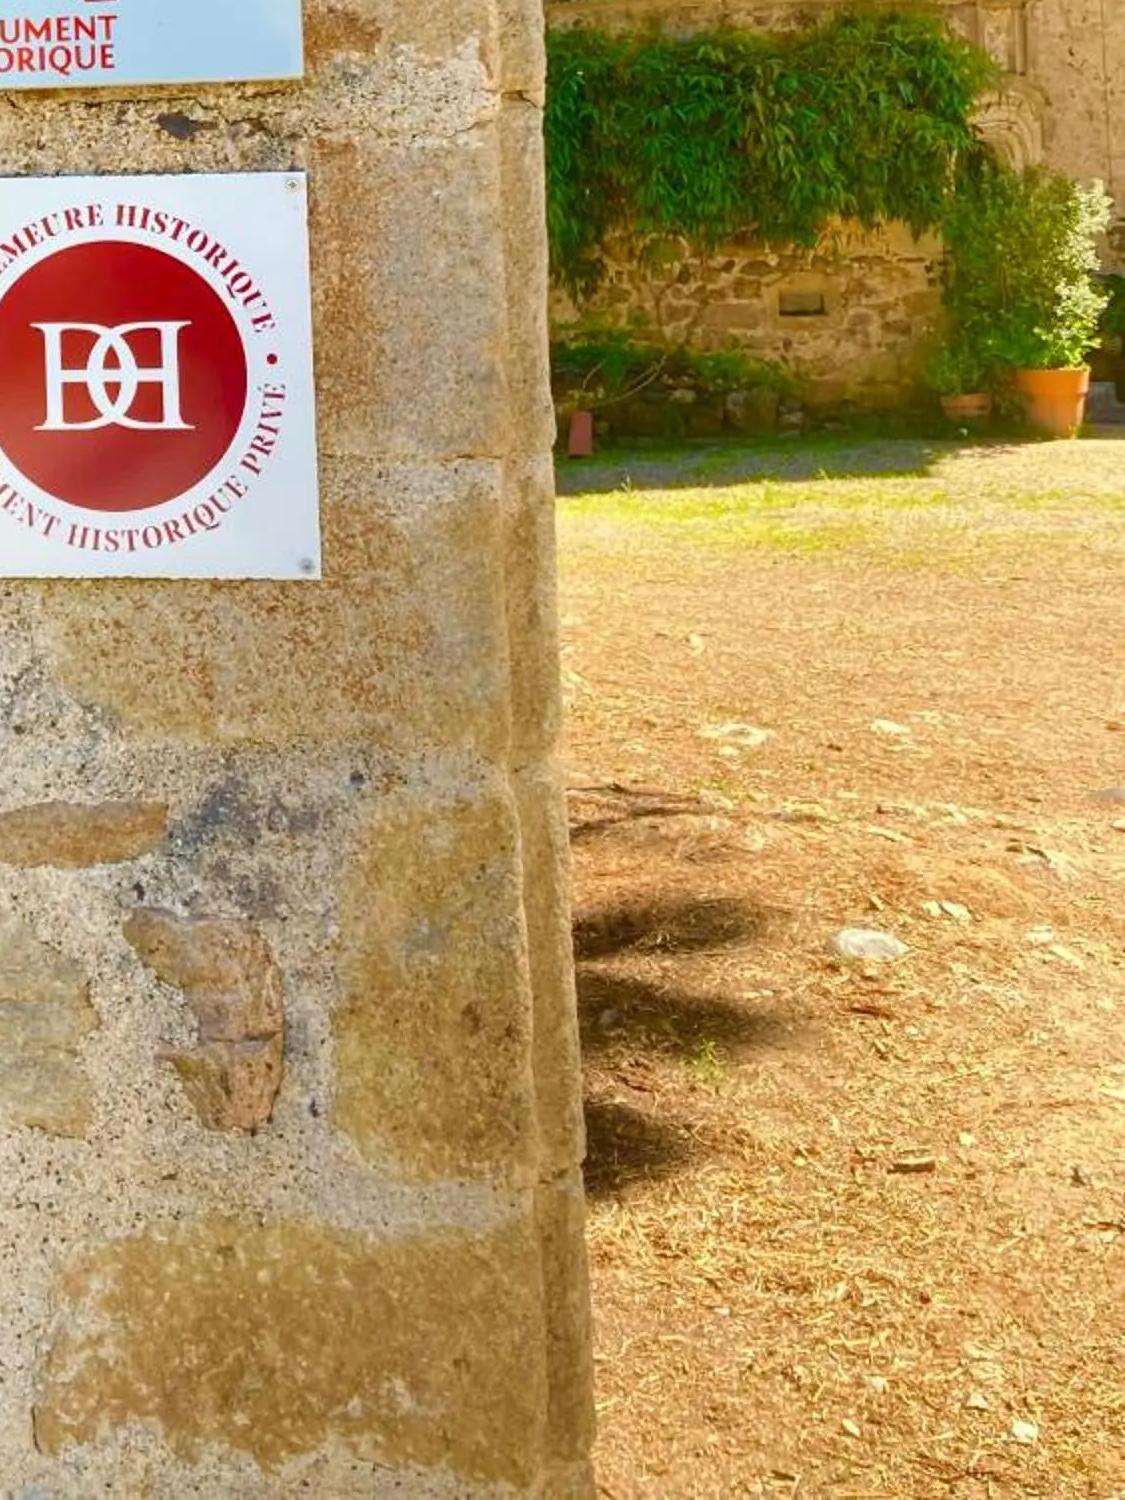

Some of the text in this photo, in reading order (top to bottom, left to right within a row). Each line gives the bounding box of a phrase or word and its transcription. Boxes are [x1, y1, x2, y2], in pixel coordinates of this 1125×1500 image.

[115, 204, 277, 334] HISTORIQUE
[67, 475, 249, 553] HISTORIQUE
[241, 383, 287, 476] PRIVÉ
